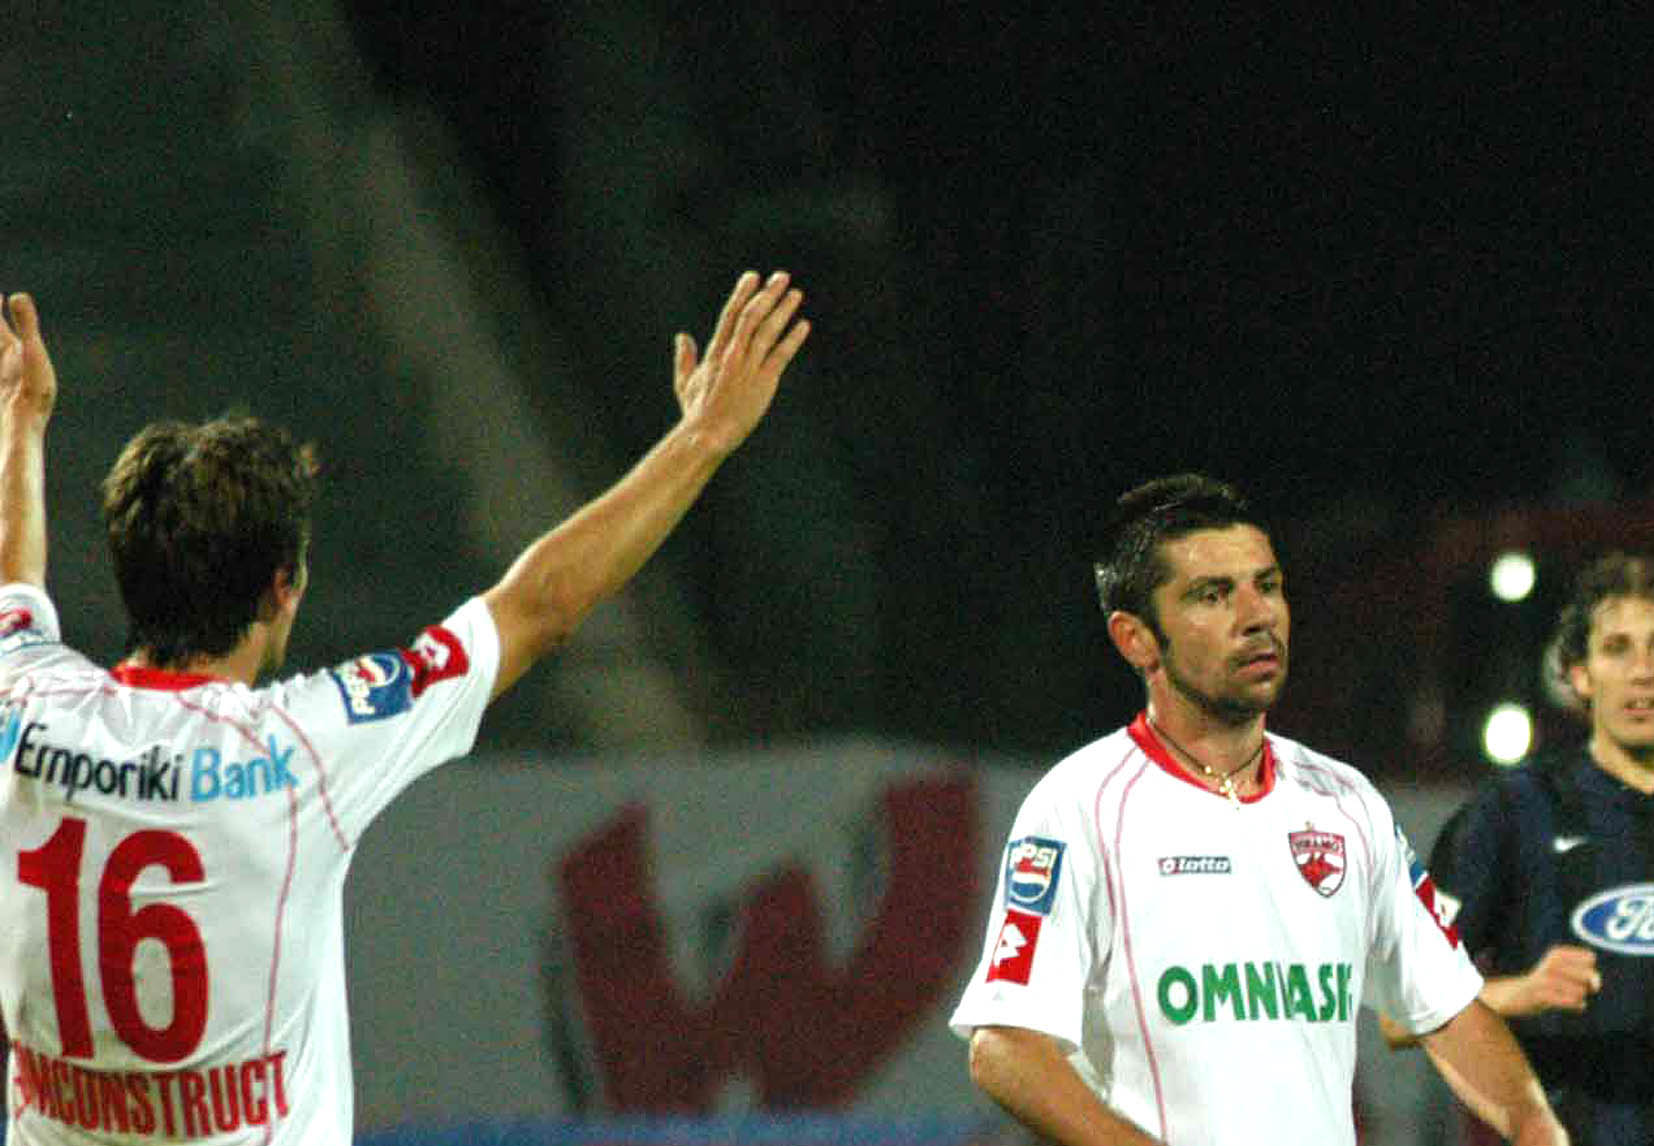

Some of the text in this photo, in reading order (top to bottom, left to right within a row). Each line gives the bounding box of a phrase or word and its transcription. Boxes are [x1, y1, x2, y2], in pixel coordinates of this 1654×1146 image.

[14, 721, 298, 802] Emporiki Bank
[1009, 843, 1058, 869] PSI
[17, 816, 210, 1063] 16
[1157, 961, 1354, 1026] OMNASI
